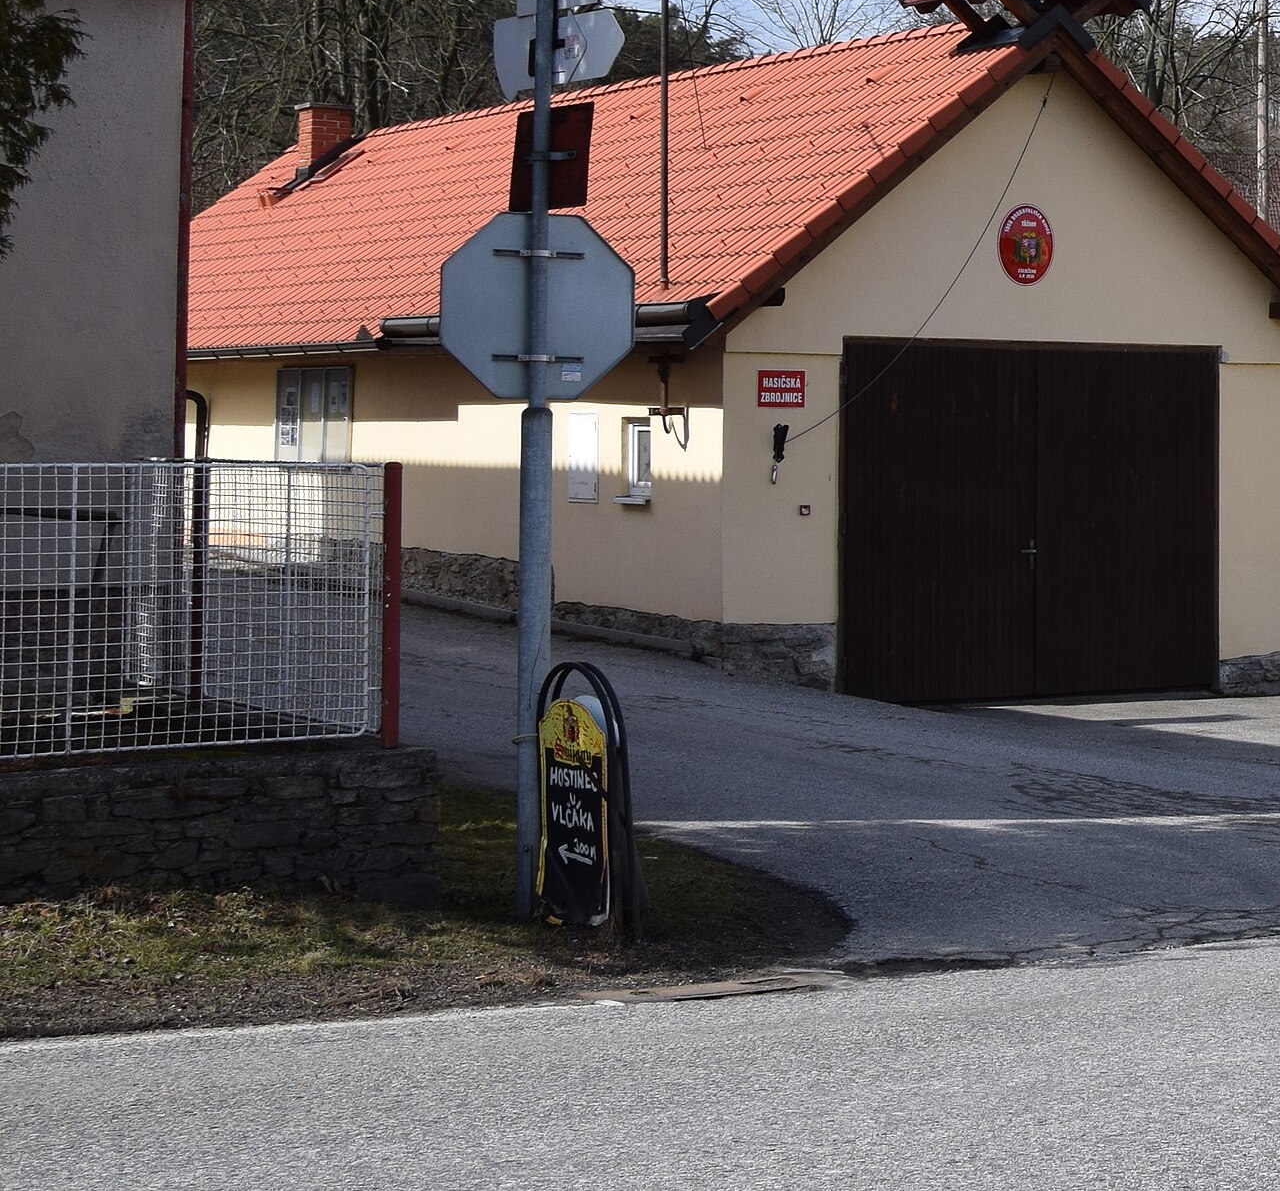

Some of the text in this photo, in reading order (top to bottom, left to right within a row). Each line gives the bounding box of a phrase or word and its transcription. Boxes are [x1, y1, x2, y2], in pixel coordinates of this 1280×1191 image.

[763, 375, 801, 388] HASIČSKÁ
[761, 392, 803, 403] ZBROJNICE
[549, 766, 598, 792] HOSTINEC
[569, 792, 576, 806] U
[551, 800, 595, 833] VLČÁKA
